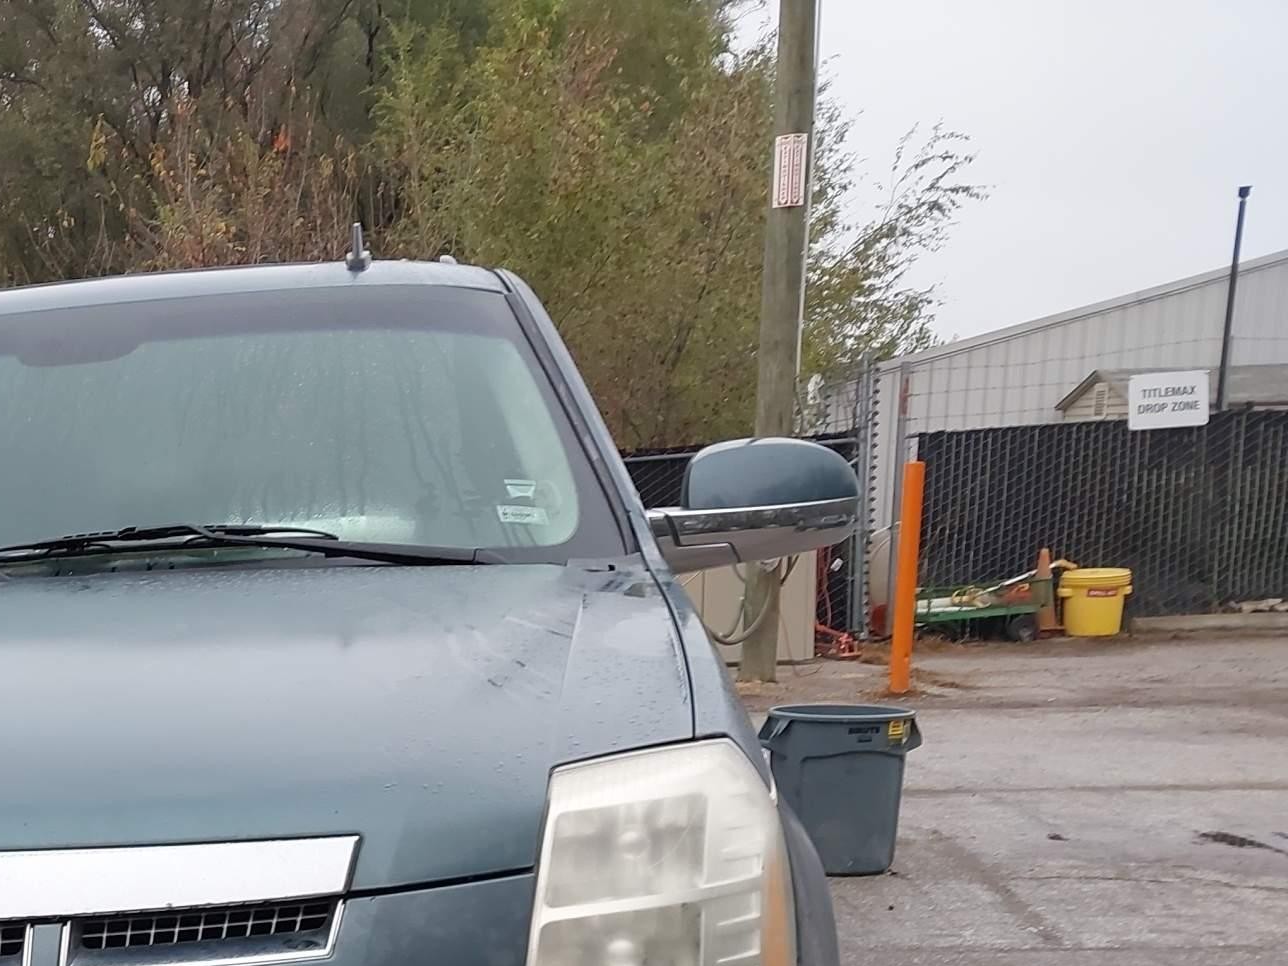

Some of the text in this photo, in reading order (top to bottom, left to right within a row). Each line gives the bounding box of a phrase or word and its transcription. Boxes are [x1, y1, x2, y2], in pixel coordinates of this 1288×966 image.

[1141, 385, 1197, 399] TITLEMAX
[1137, 400, 1201, 415] DROP ZONE
